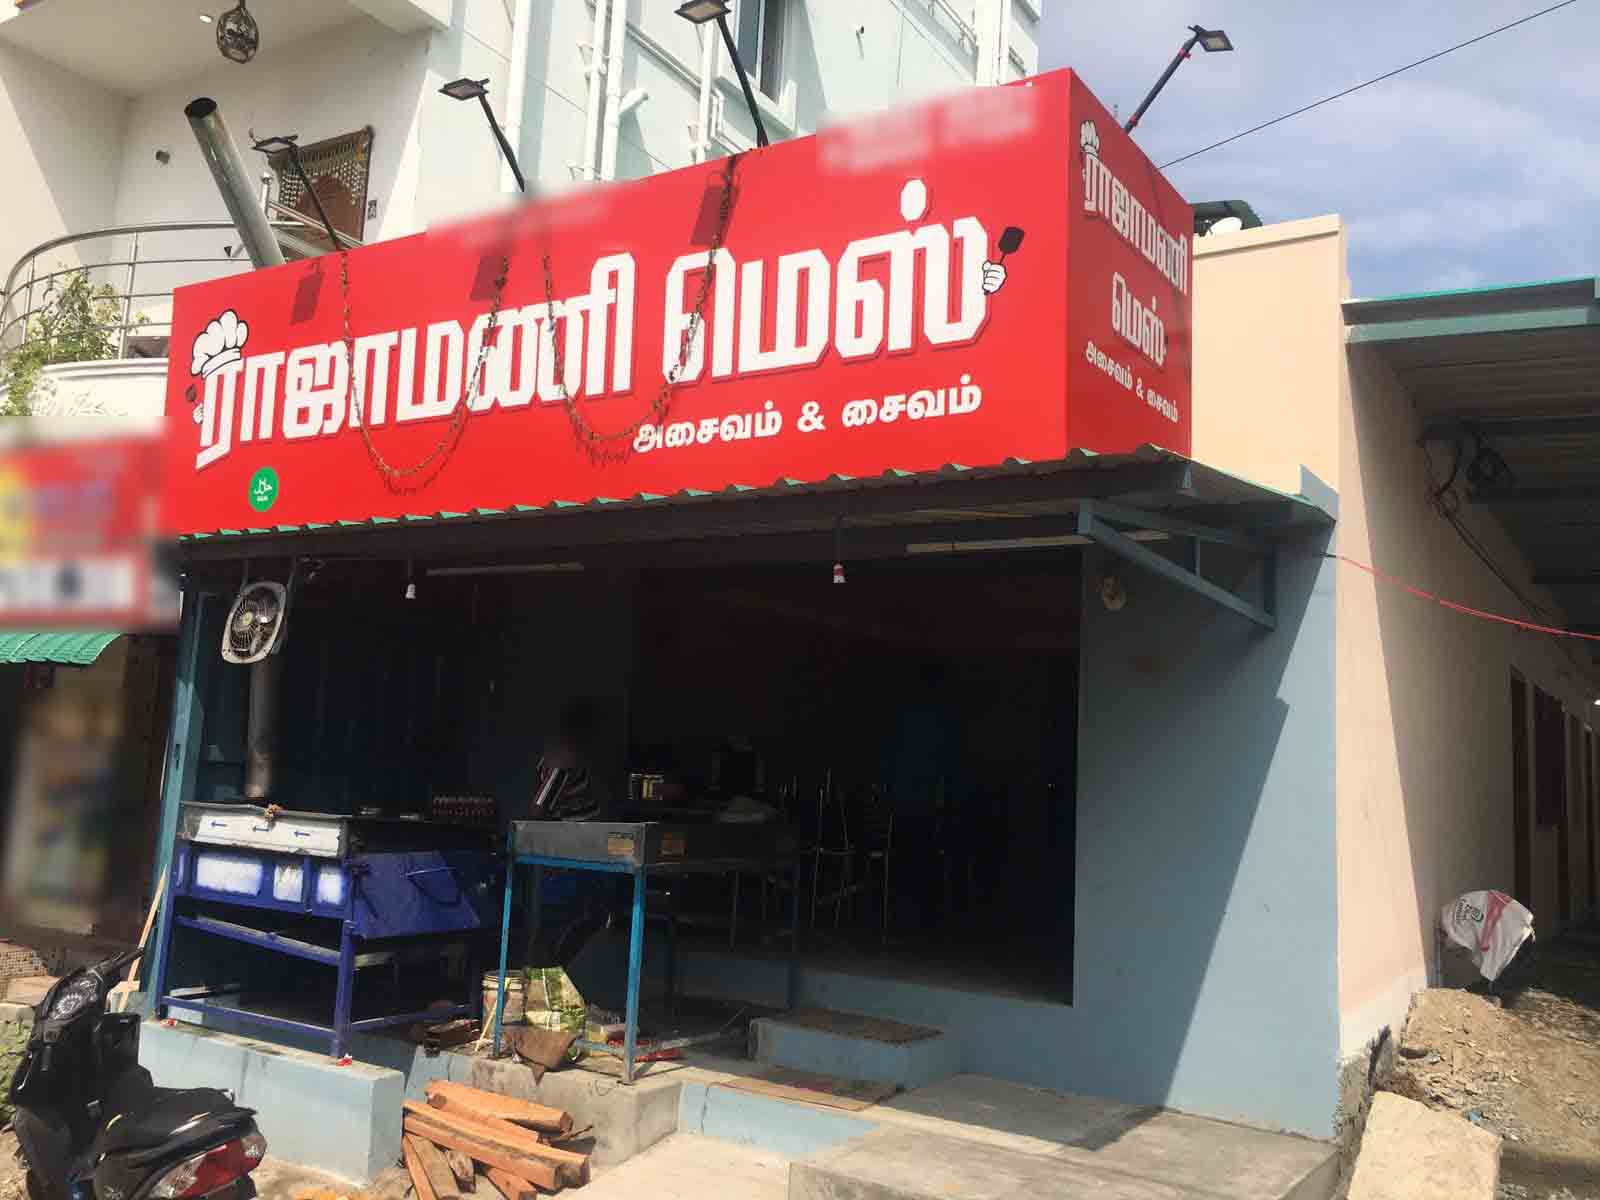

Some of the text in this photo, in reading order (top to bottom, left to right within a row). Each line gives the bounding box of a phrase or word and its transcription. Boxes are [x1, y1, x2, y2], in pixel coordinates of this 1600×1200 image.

[1083, 154, 1188, 297] ராஜாமணி
[195, 179, 990, 471] ராஜாமணி மெஸ்
[1111, 272, 1166, 367] மெஸ்
[632, 373, 983, 454] அசைவம் & சைவம்
[1085, 340, 1178, 424] அசைவம் & சைவம்
